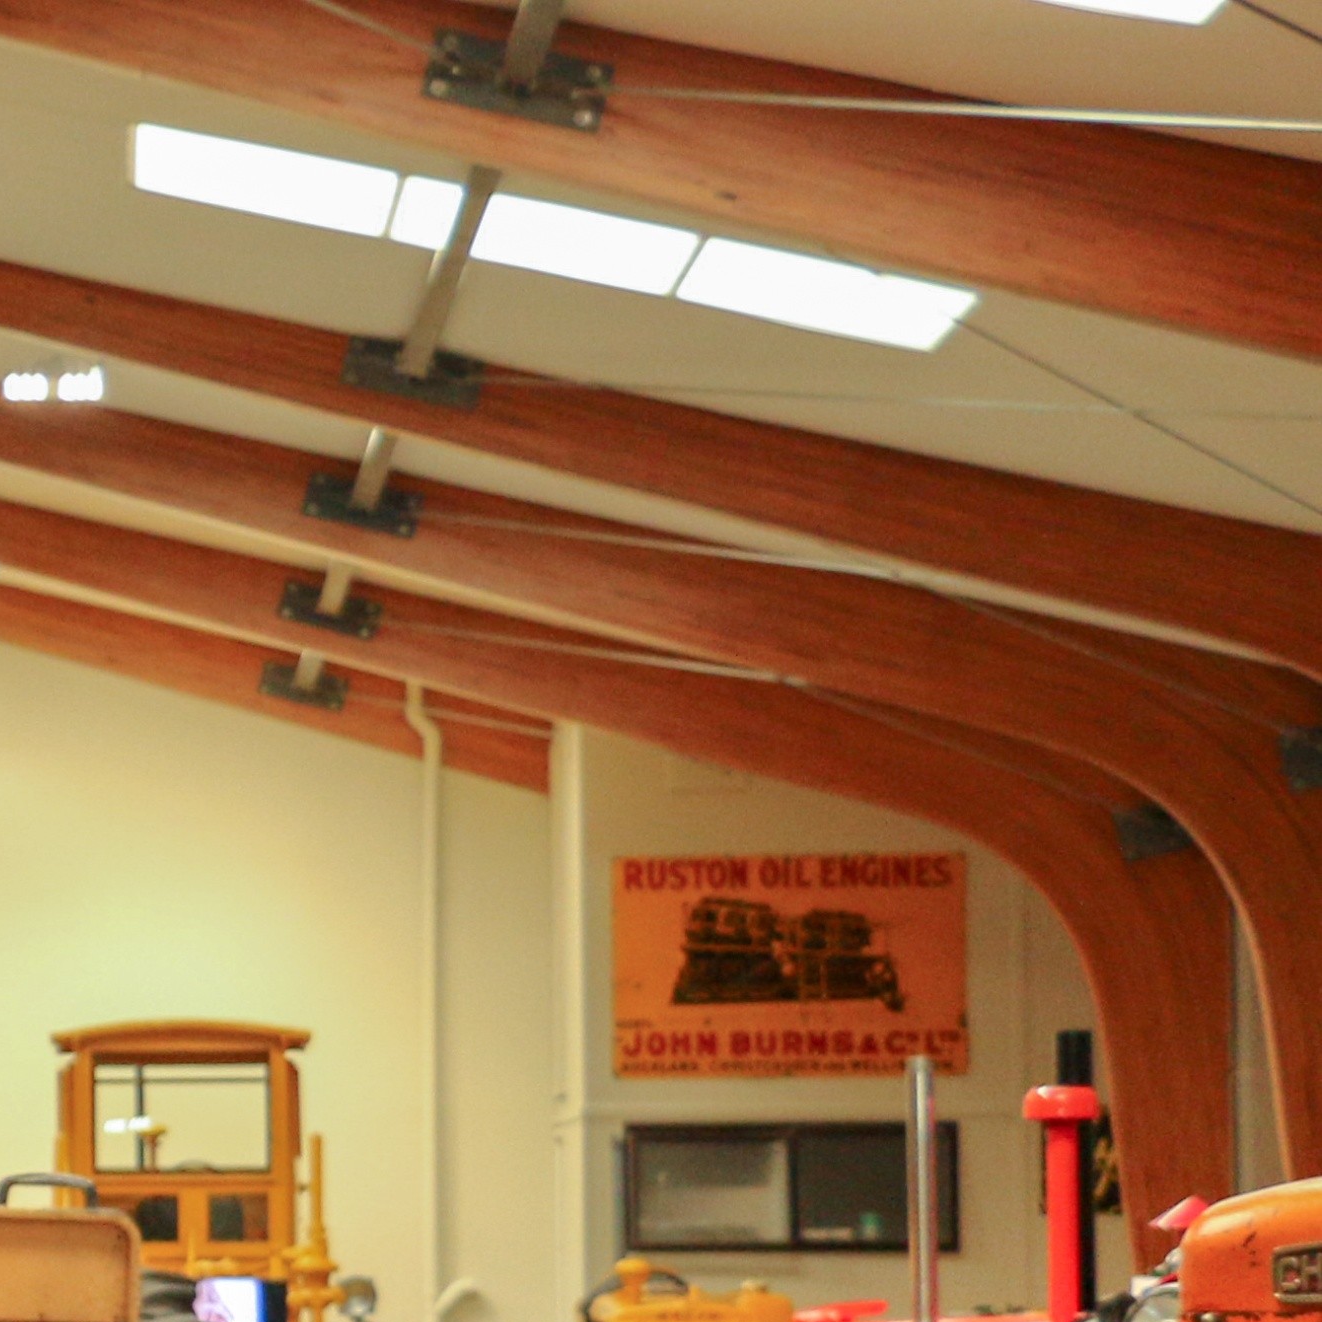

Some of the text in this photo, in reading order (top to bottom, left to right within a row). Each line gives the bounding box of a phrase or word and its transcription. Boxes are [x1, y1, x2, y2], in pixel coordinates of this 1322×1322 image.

[623, 854, 955, 890] RUSTON OIL ENGINES
[621, 1030, 719, 1057] JOHN
